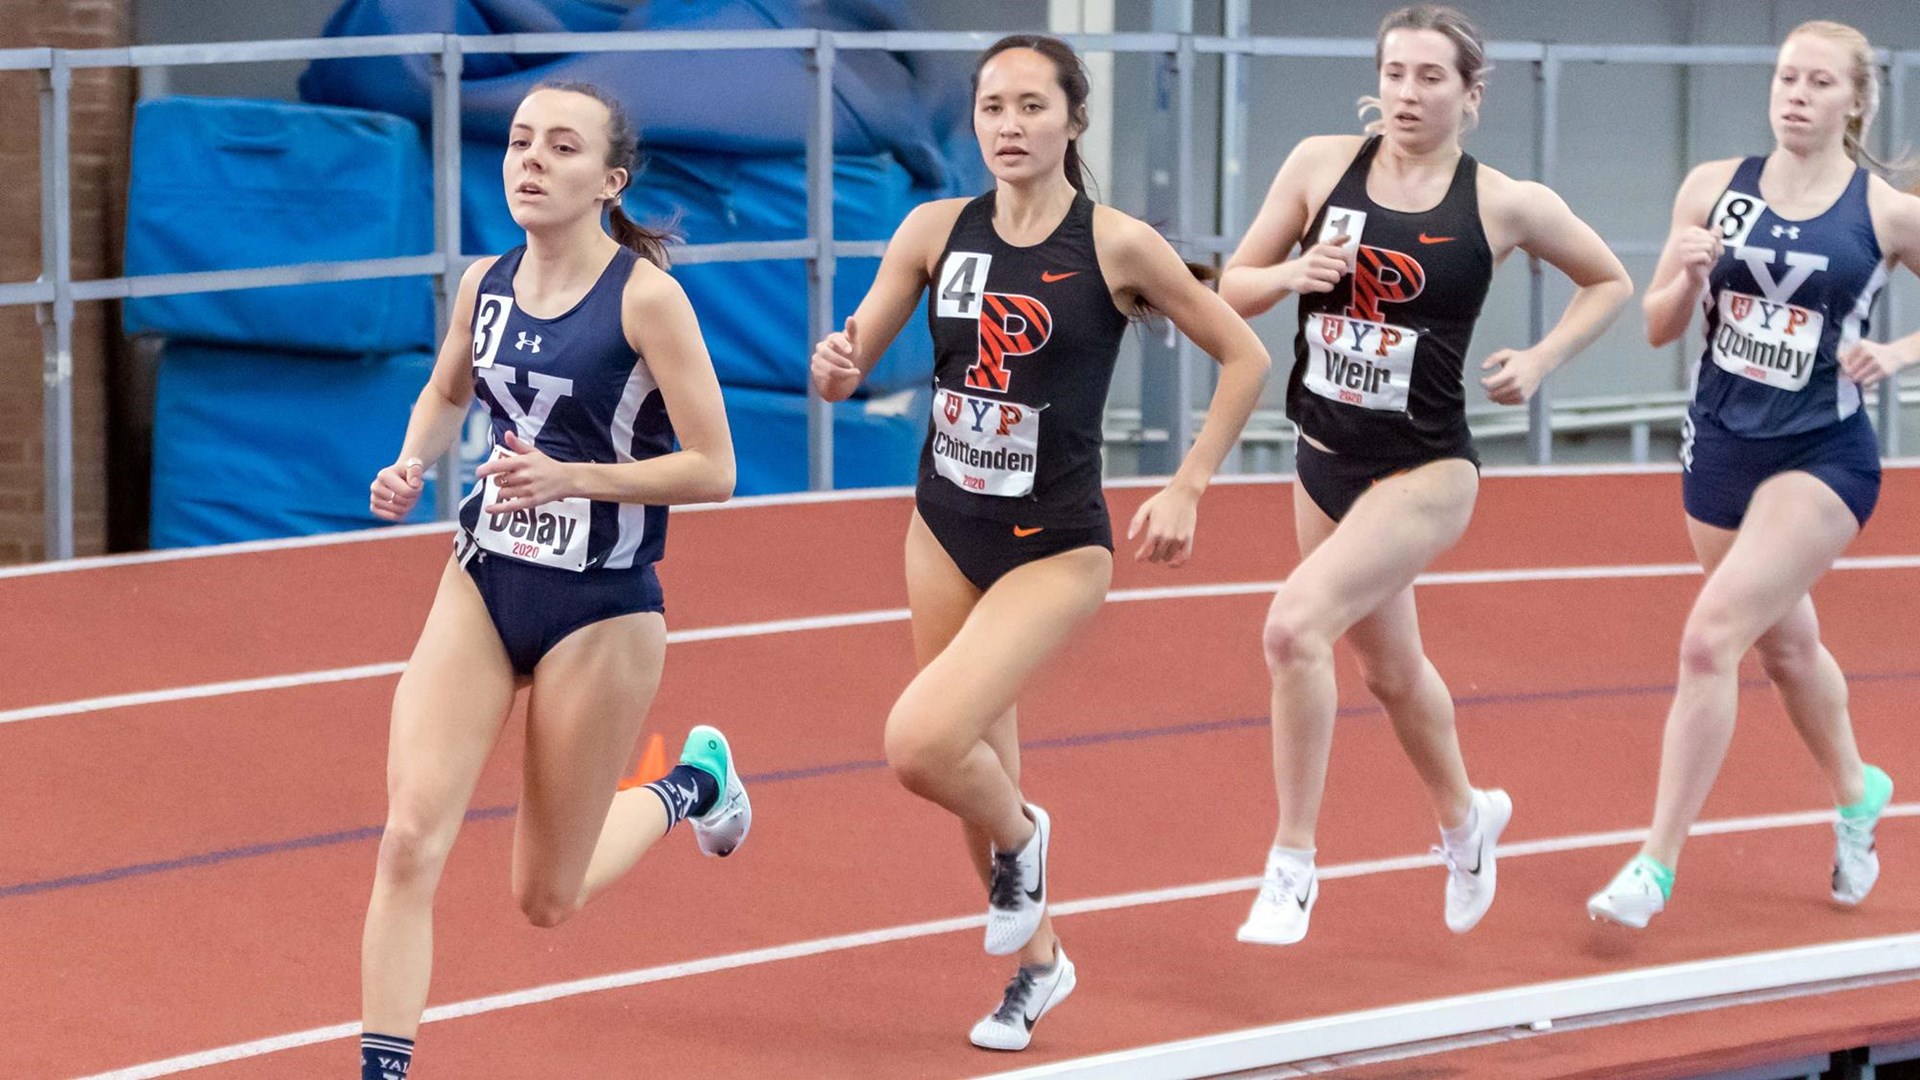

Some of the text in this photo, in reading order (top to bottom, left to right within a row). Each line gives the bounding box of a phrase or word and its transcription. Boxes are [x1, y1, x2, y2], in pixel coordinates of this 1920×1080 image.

[1720, 198, 1753, 239] 8
[942, 257, 979, 313] 4
[1344, 244, 1426, 323] P
[1734, 246, 1830, 303] Y
[474, 299, 504, 362] 3
[965, 291, 1053, 393] P
[1717, 323, 1812, 379] Quimby
[1324, 347, 1391, 394] Weir
[1339, 389, 1363, 404] 2020
[478, 363, 574, 448] Y
[934, 431, 1034, 472] Chittenden
[963, 474, 985, 490] 2020
[489, 493, 577, 556] Delay
[512, 541, 539, 559] 2020
